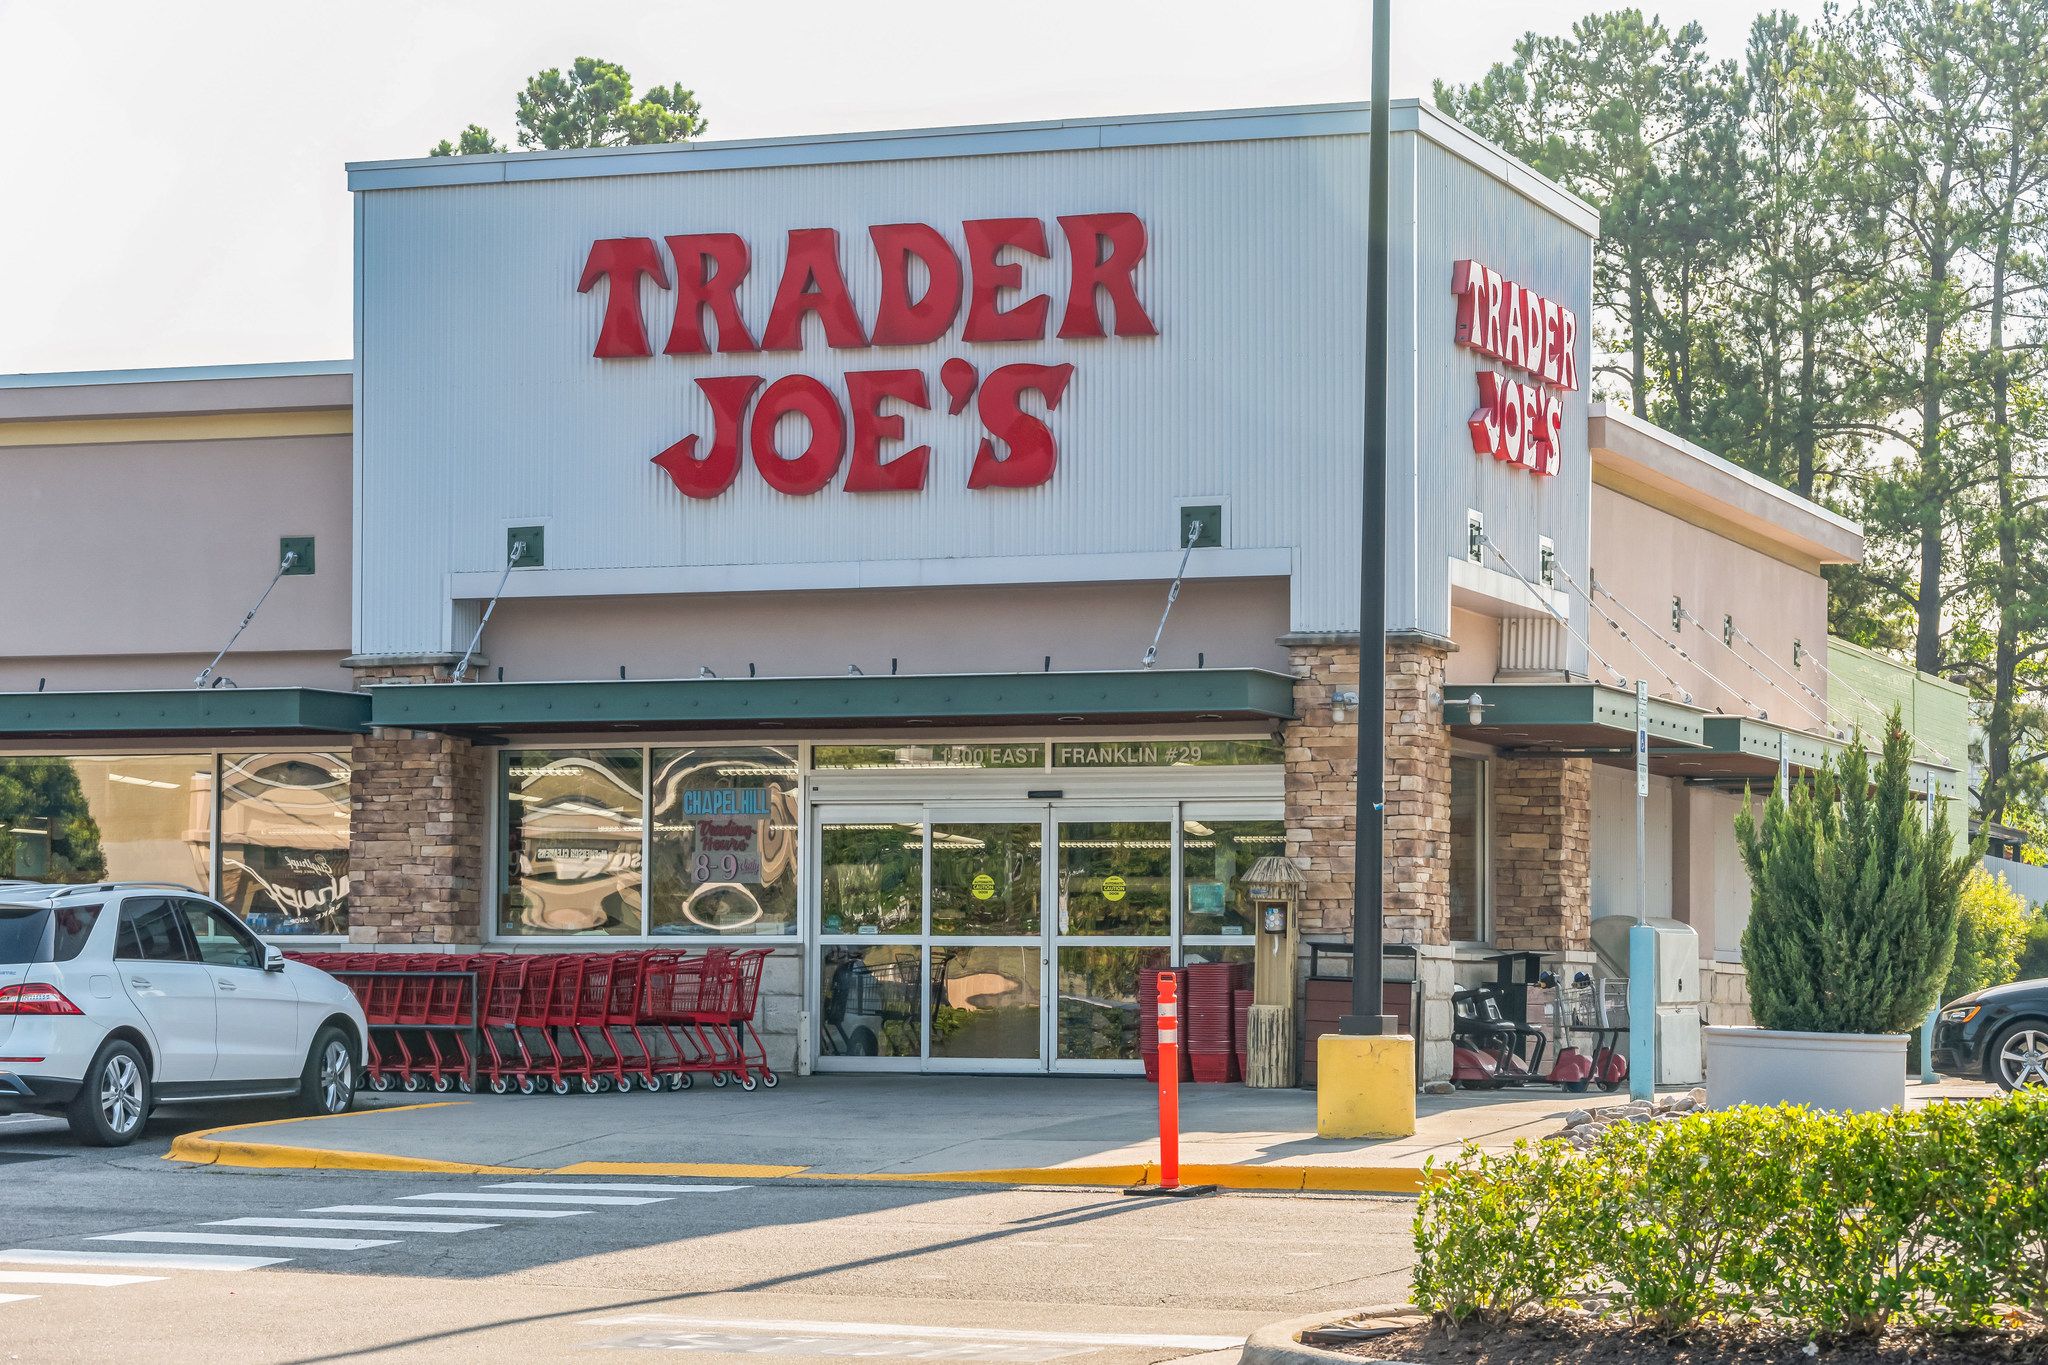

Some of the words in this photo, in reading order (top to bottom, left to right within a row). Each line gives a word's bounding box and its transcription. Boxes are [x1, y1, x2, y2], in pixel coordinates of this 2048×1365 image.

[576, 212, 1160, 358] TRADER
[1451, 259, 1579, 391] TRADER
[650, 357, 1076, 500] JOE'S
[1468, 371, 1563, 477] JOE'S
[683, 789, 740, 815] CHAPEL
[742, 788, 770, 815] HILL
[991, 748, 1040, 763] EAST
[1061, 748, 1158, 763] FRANKLIN
[1165, 746, 1202, 762] #29
[700, 836, 749, 851] Hours
